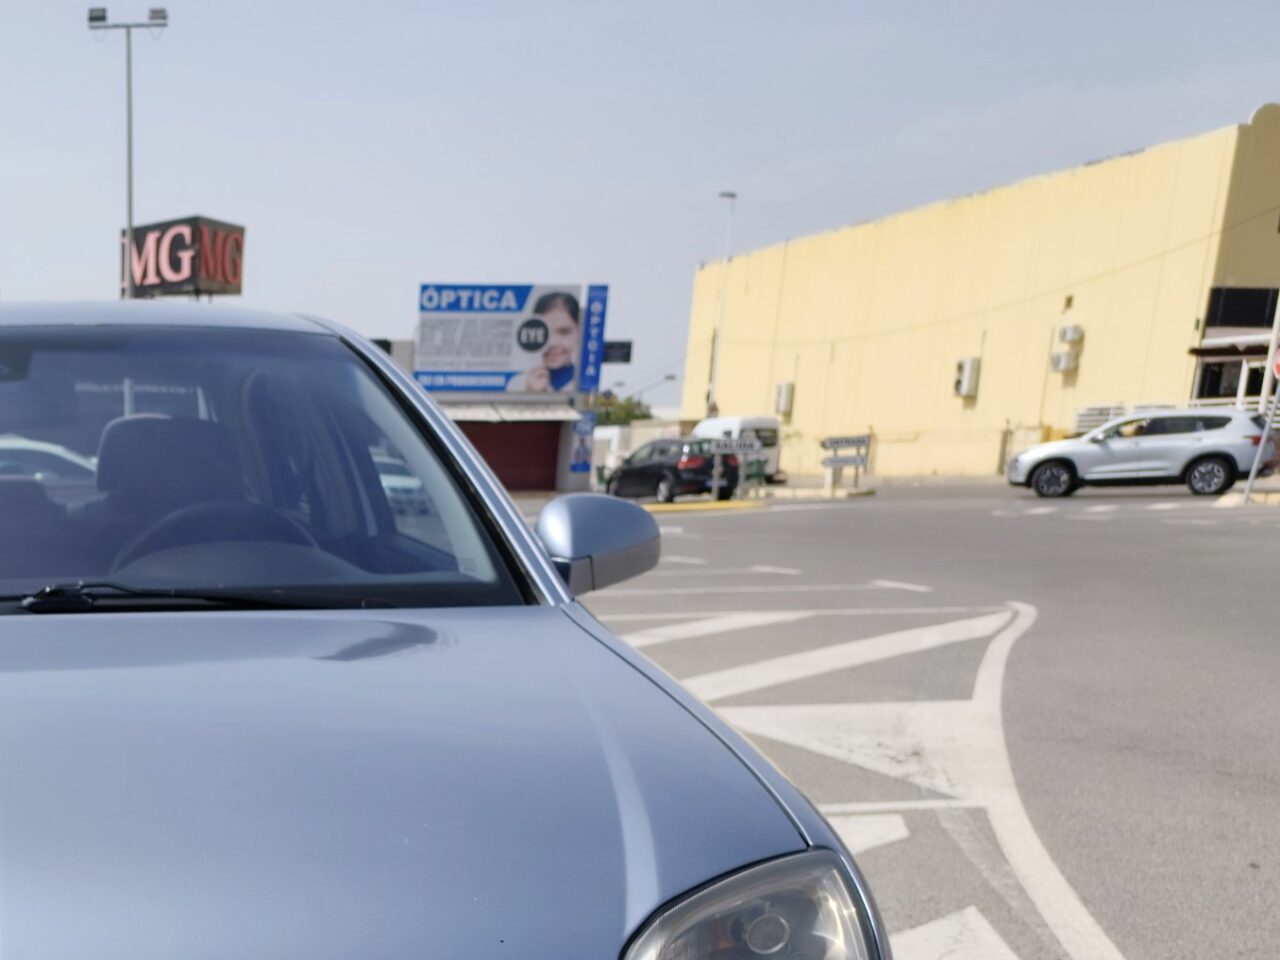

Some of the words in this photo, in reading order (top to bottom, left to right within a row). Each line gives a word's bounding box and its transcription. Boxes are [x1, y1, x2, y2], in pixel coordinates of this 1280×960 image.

[121, 225, 195, 287] MG
[199, 224, 242, 284] MG
[421, 285, 518, 310] ÓPTICA
